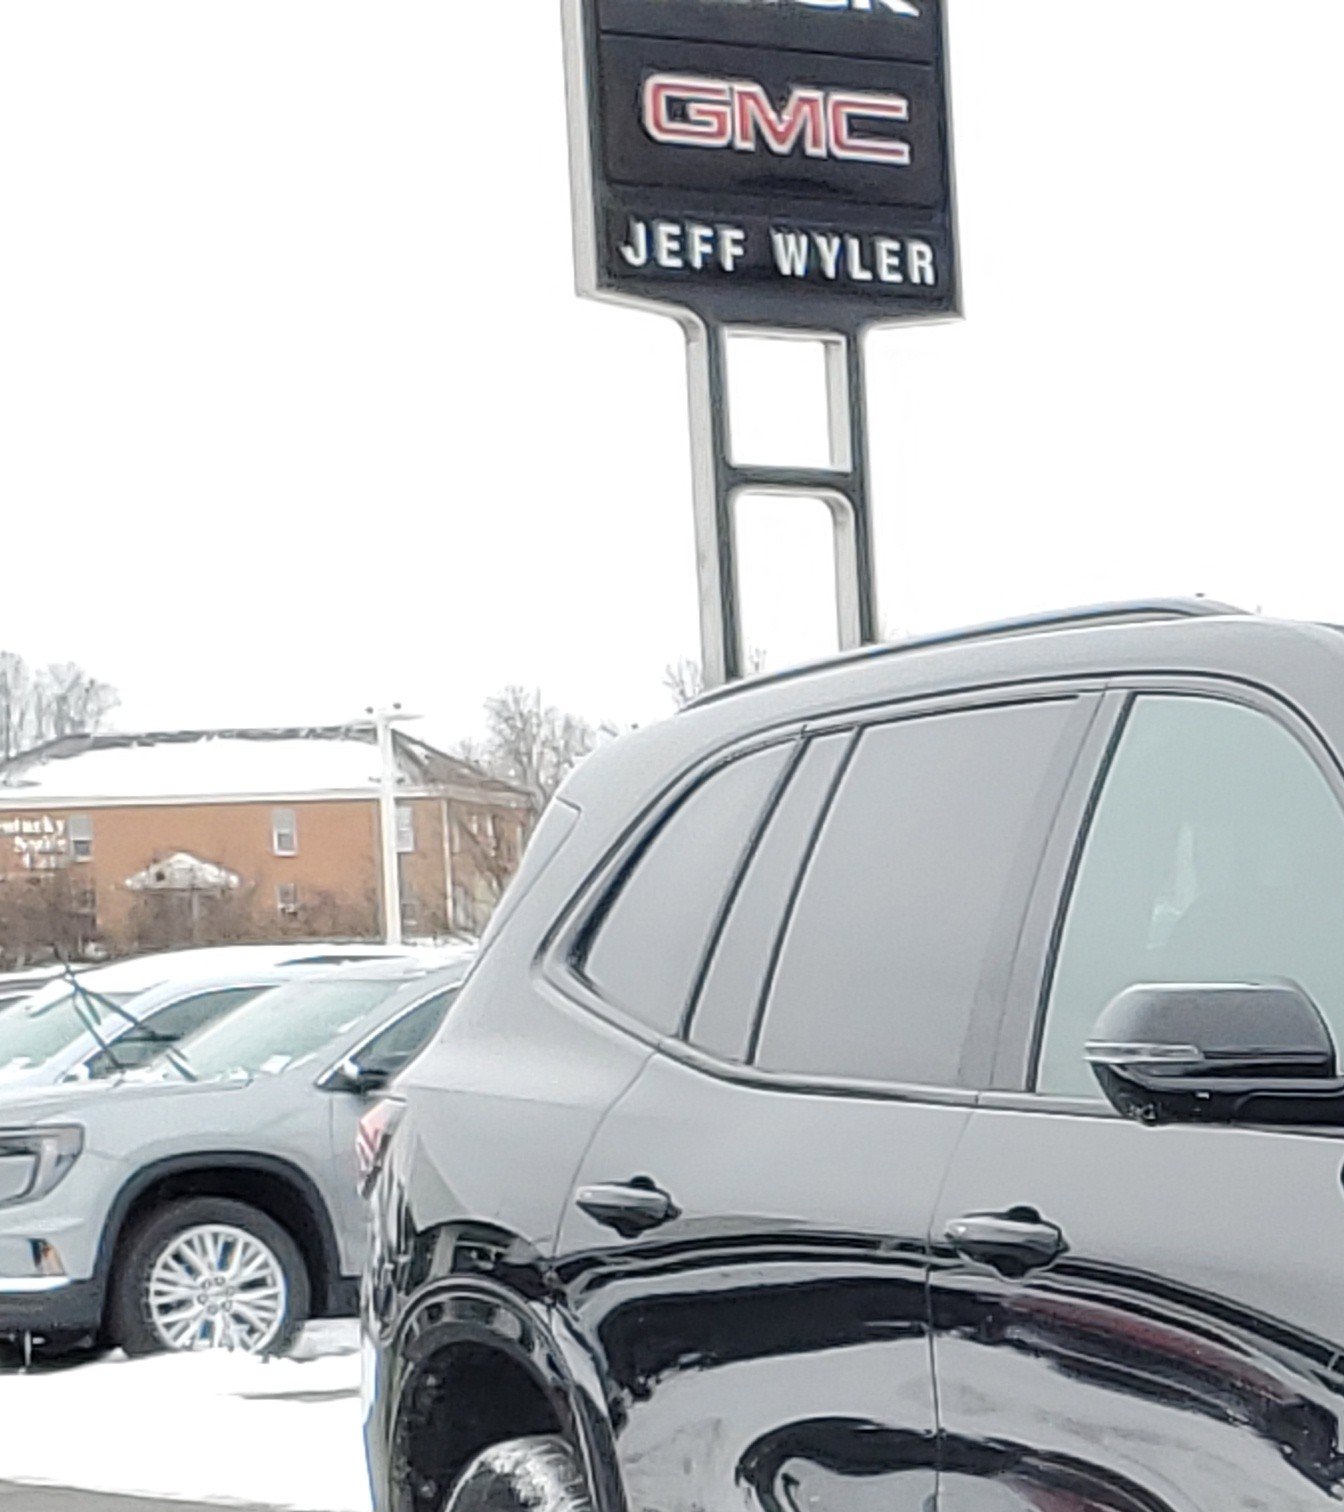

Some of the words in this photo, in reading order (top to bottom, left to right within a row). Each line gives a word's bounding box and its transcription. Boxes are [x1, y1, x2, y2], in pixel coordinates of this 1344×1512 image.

[642, 71, 911, 167] GMC
[620, 220, 747, 273] JEFF
[770, 227, 936, 286] WYLER
